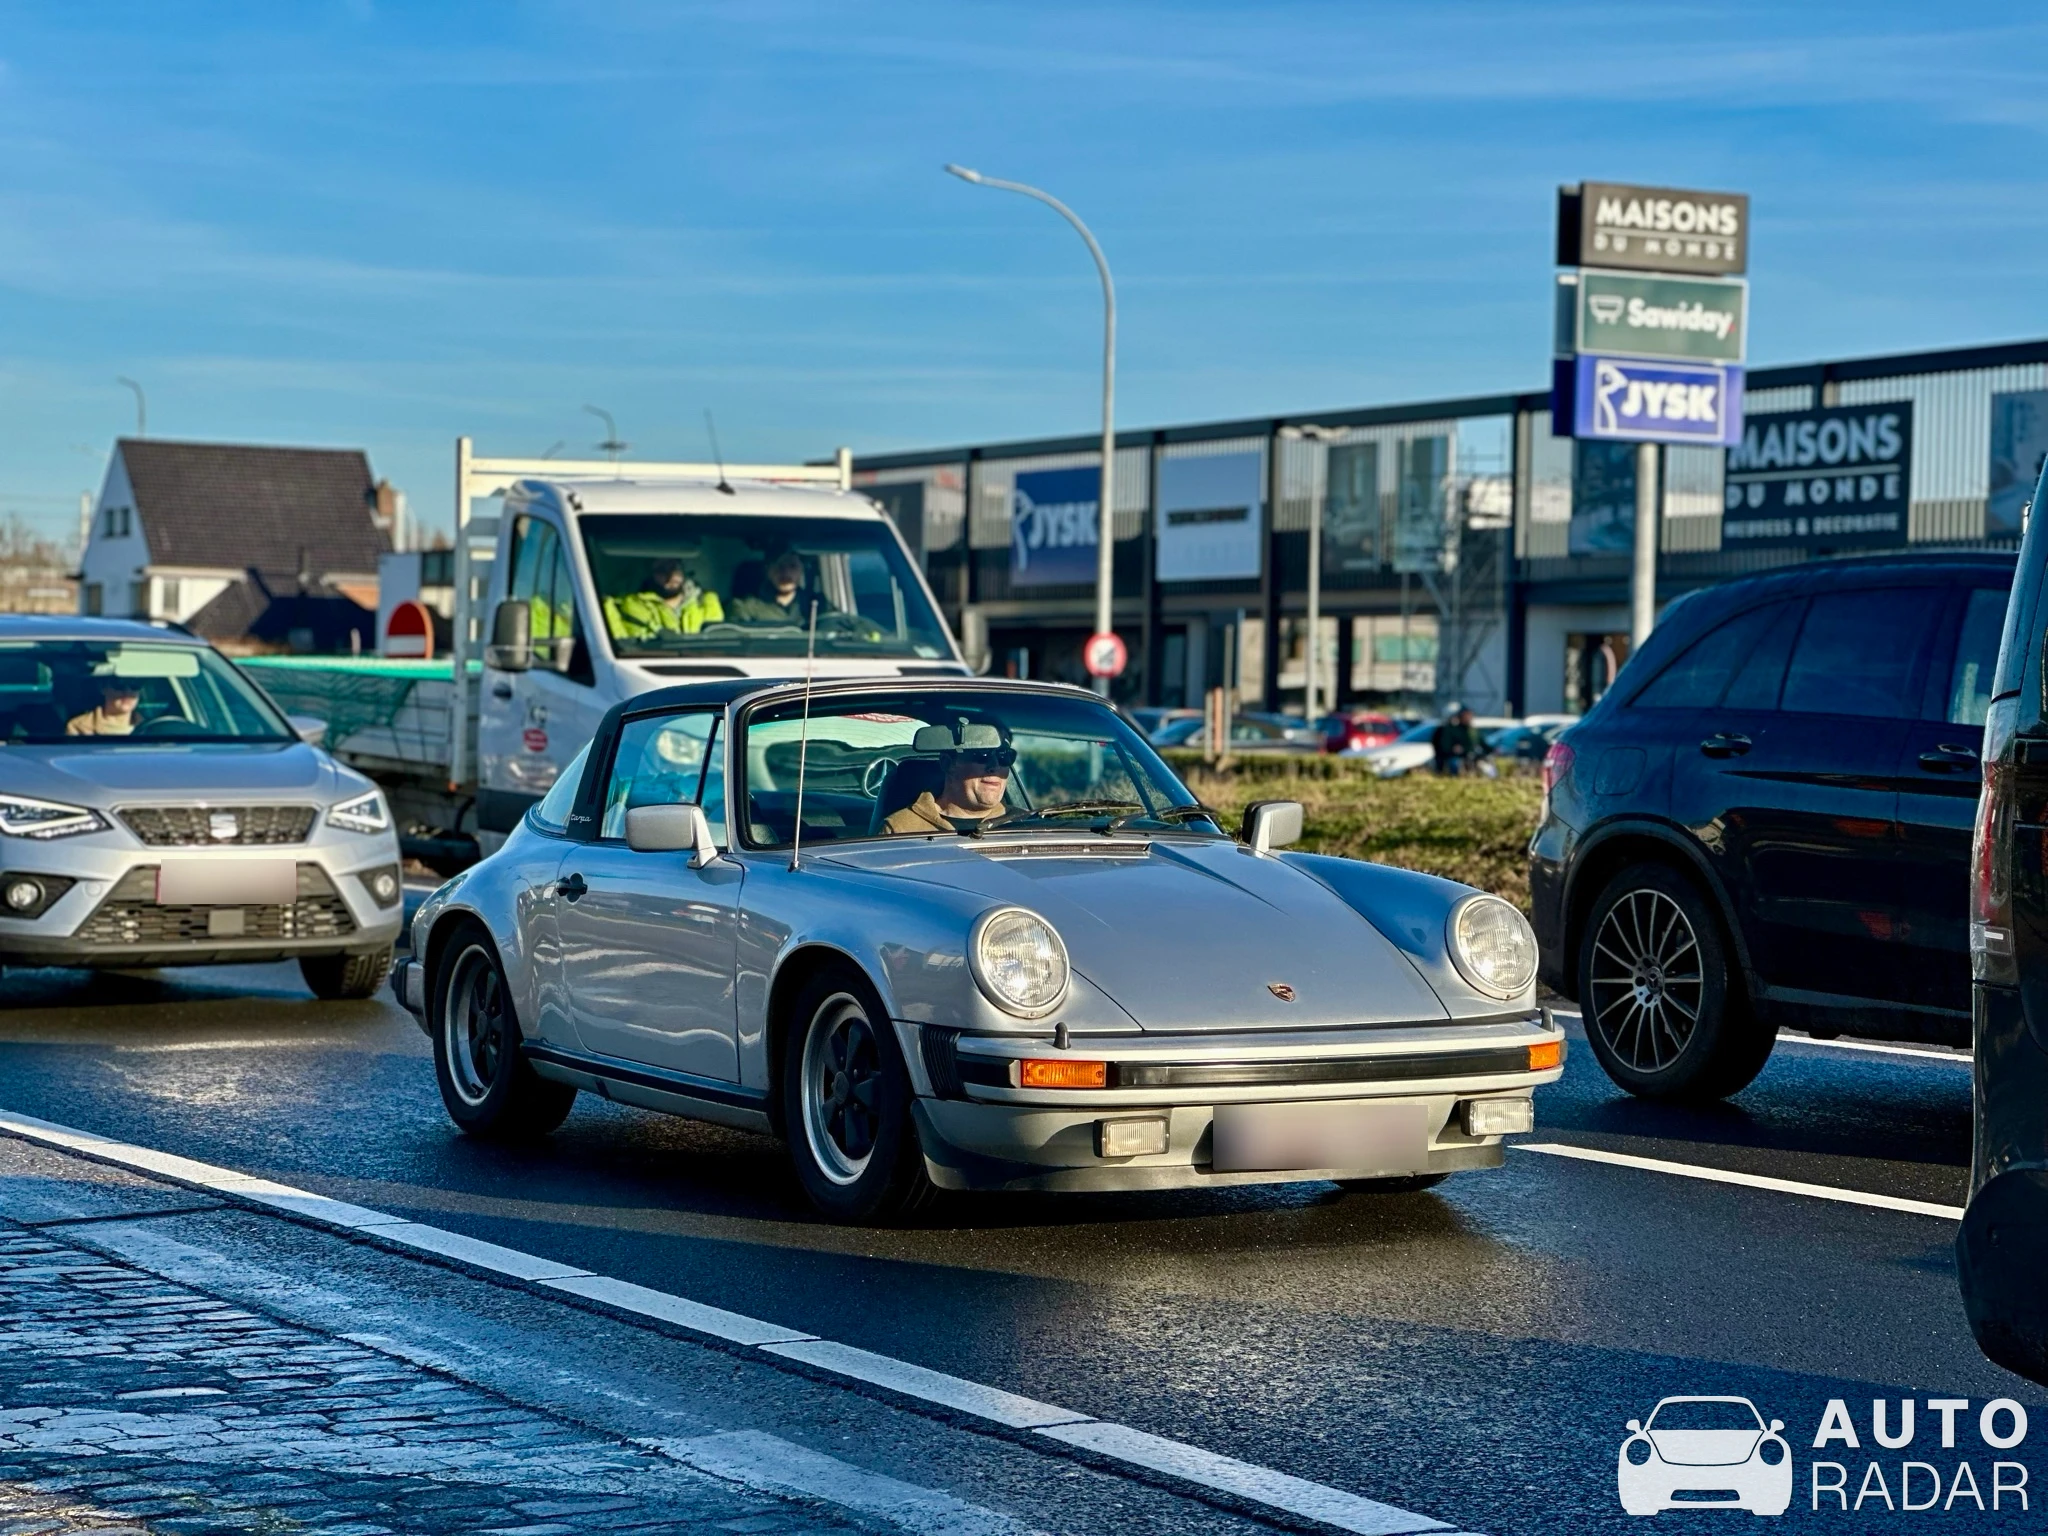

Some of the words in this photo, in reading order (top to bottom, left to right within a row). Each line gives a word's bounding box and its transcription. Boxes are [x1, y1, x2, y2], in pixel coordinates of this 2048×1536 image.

[1596, 197, 1738, 235] MAISONS
[1594, 233, 1628, 252] DU
[1645, 238, 1736, 261] MONDE
[1621, 380, 1717, 422] JYSK
[1727, 413, 1902, 470] MAISONS
[1725, 483, 1765, 509] DU
[1784, 474, 1900, 506] MONDE
[1028, 502, 1098, 549] JYSK
